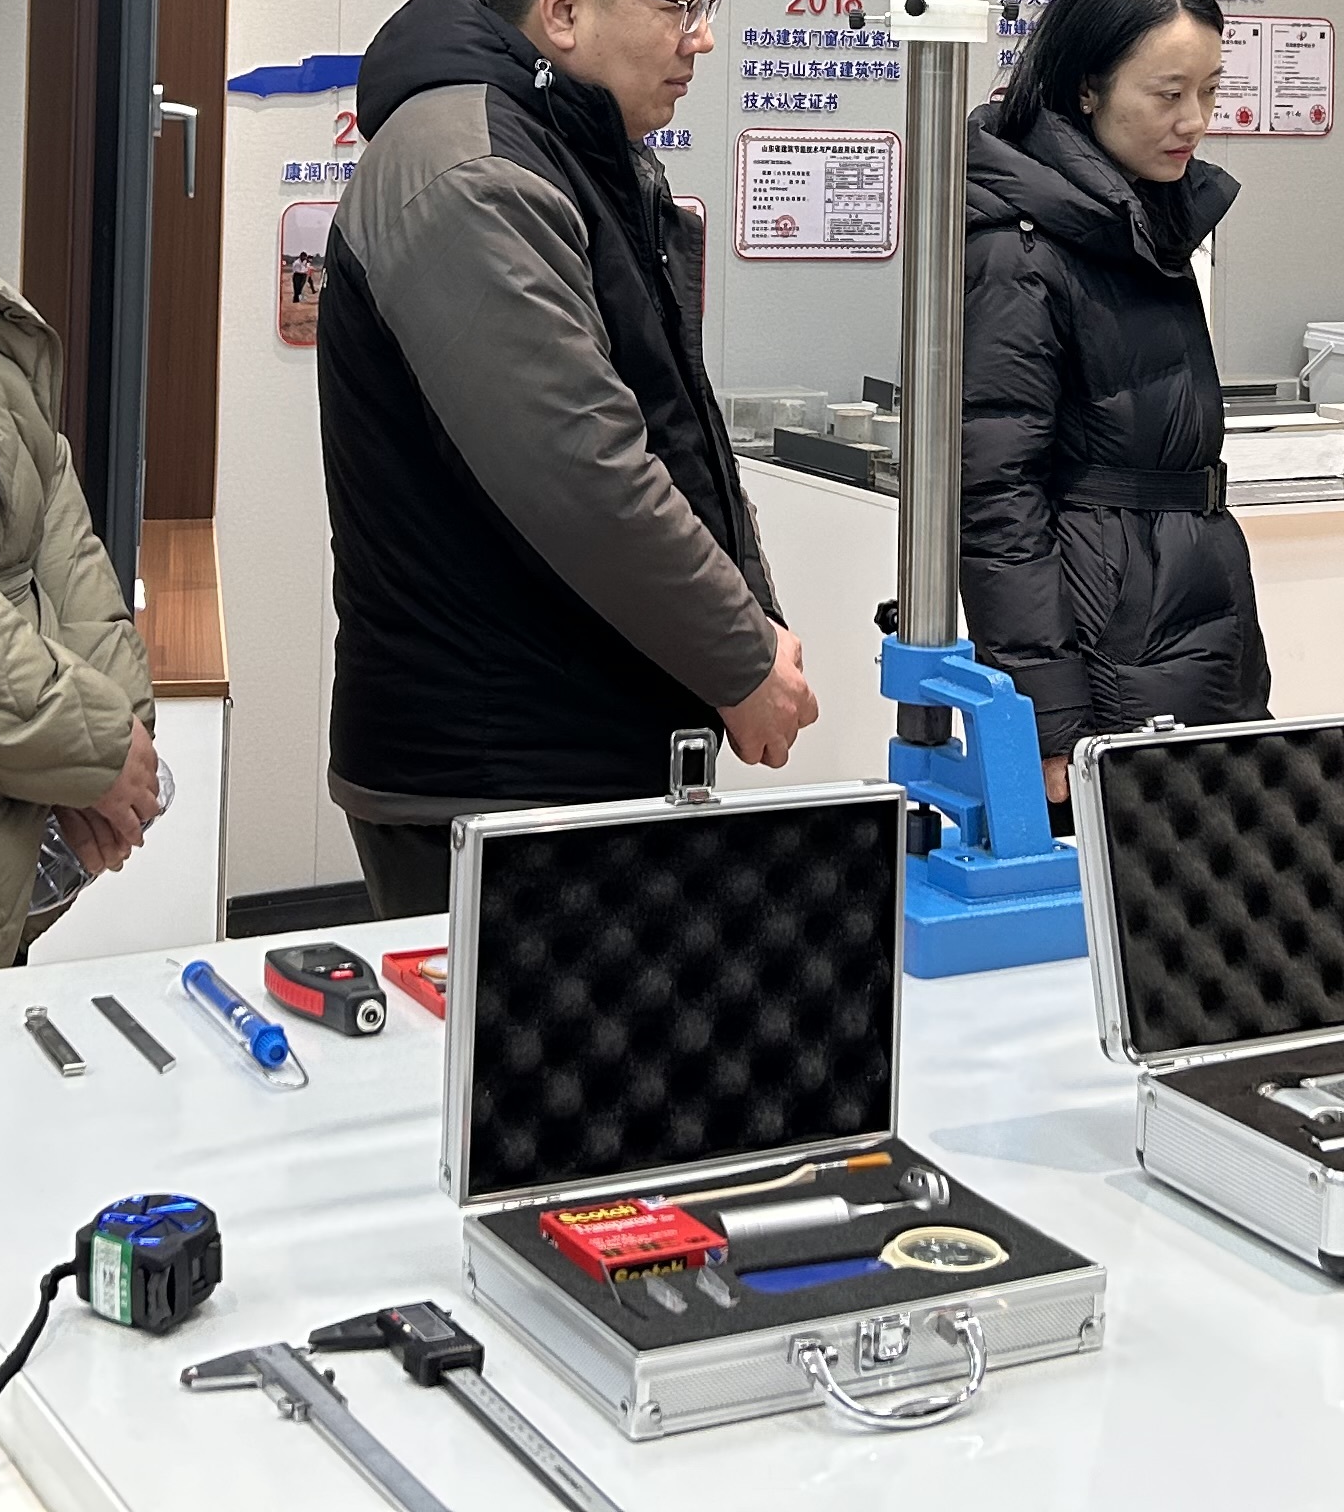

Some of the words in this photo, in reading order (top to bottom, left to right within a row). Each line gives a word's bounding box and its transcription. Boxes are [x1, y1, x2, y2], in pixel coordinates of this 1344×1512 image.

[742, 60, 900, 79] 证书与山东省建筑节能
[744, 92, 838, 110] 技术认定证书
[559, 1202, 637, 1224] Scotch
